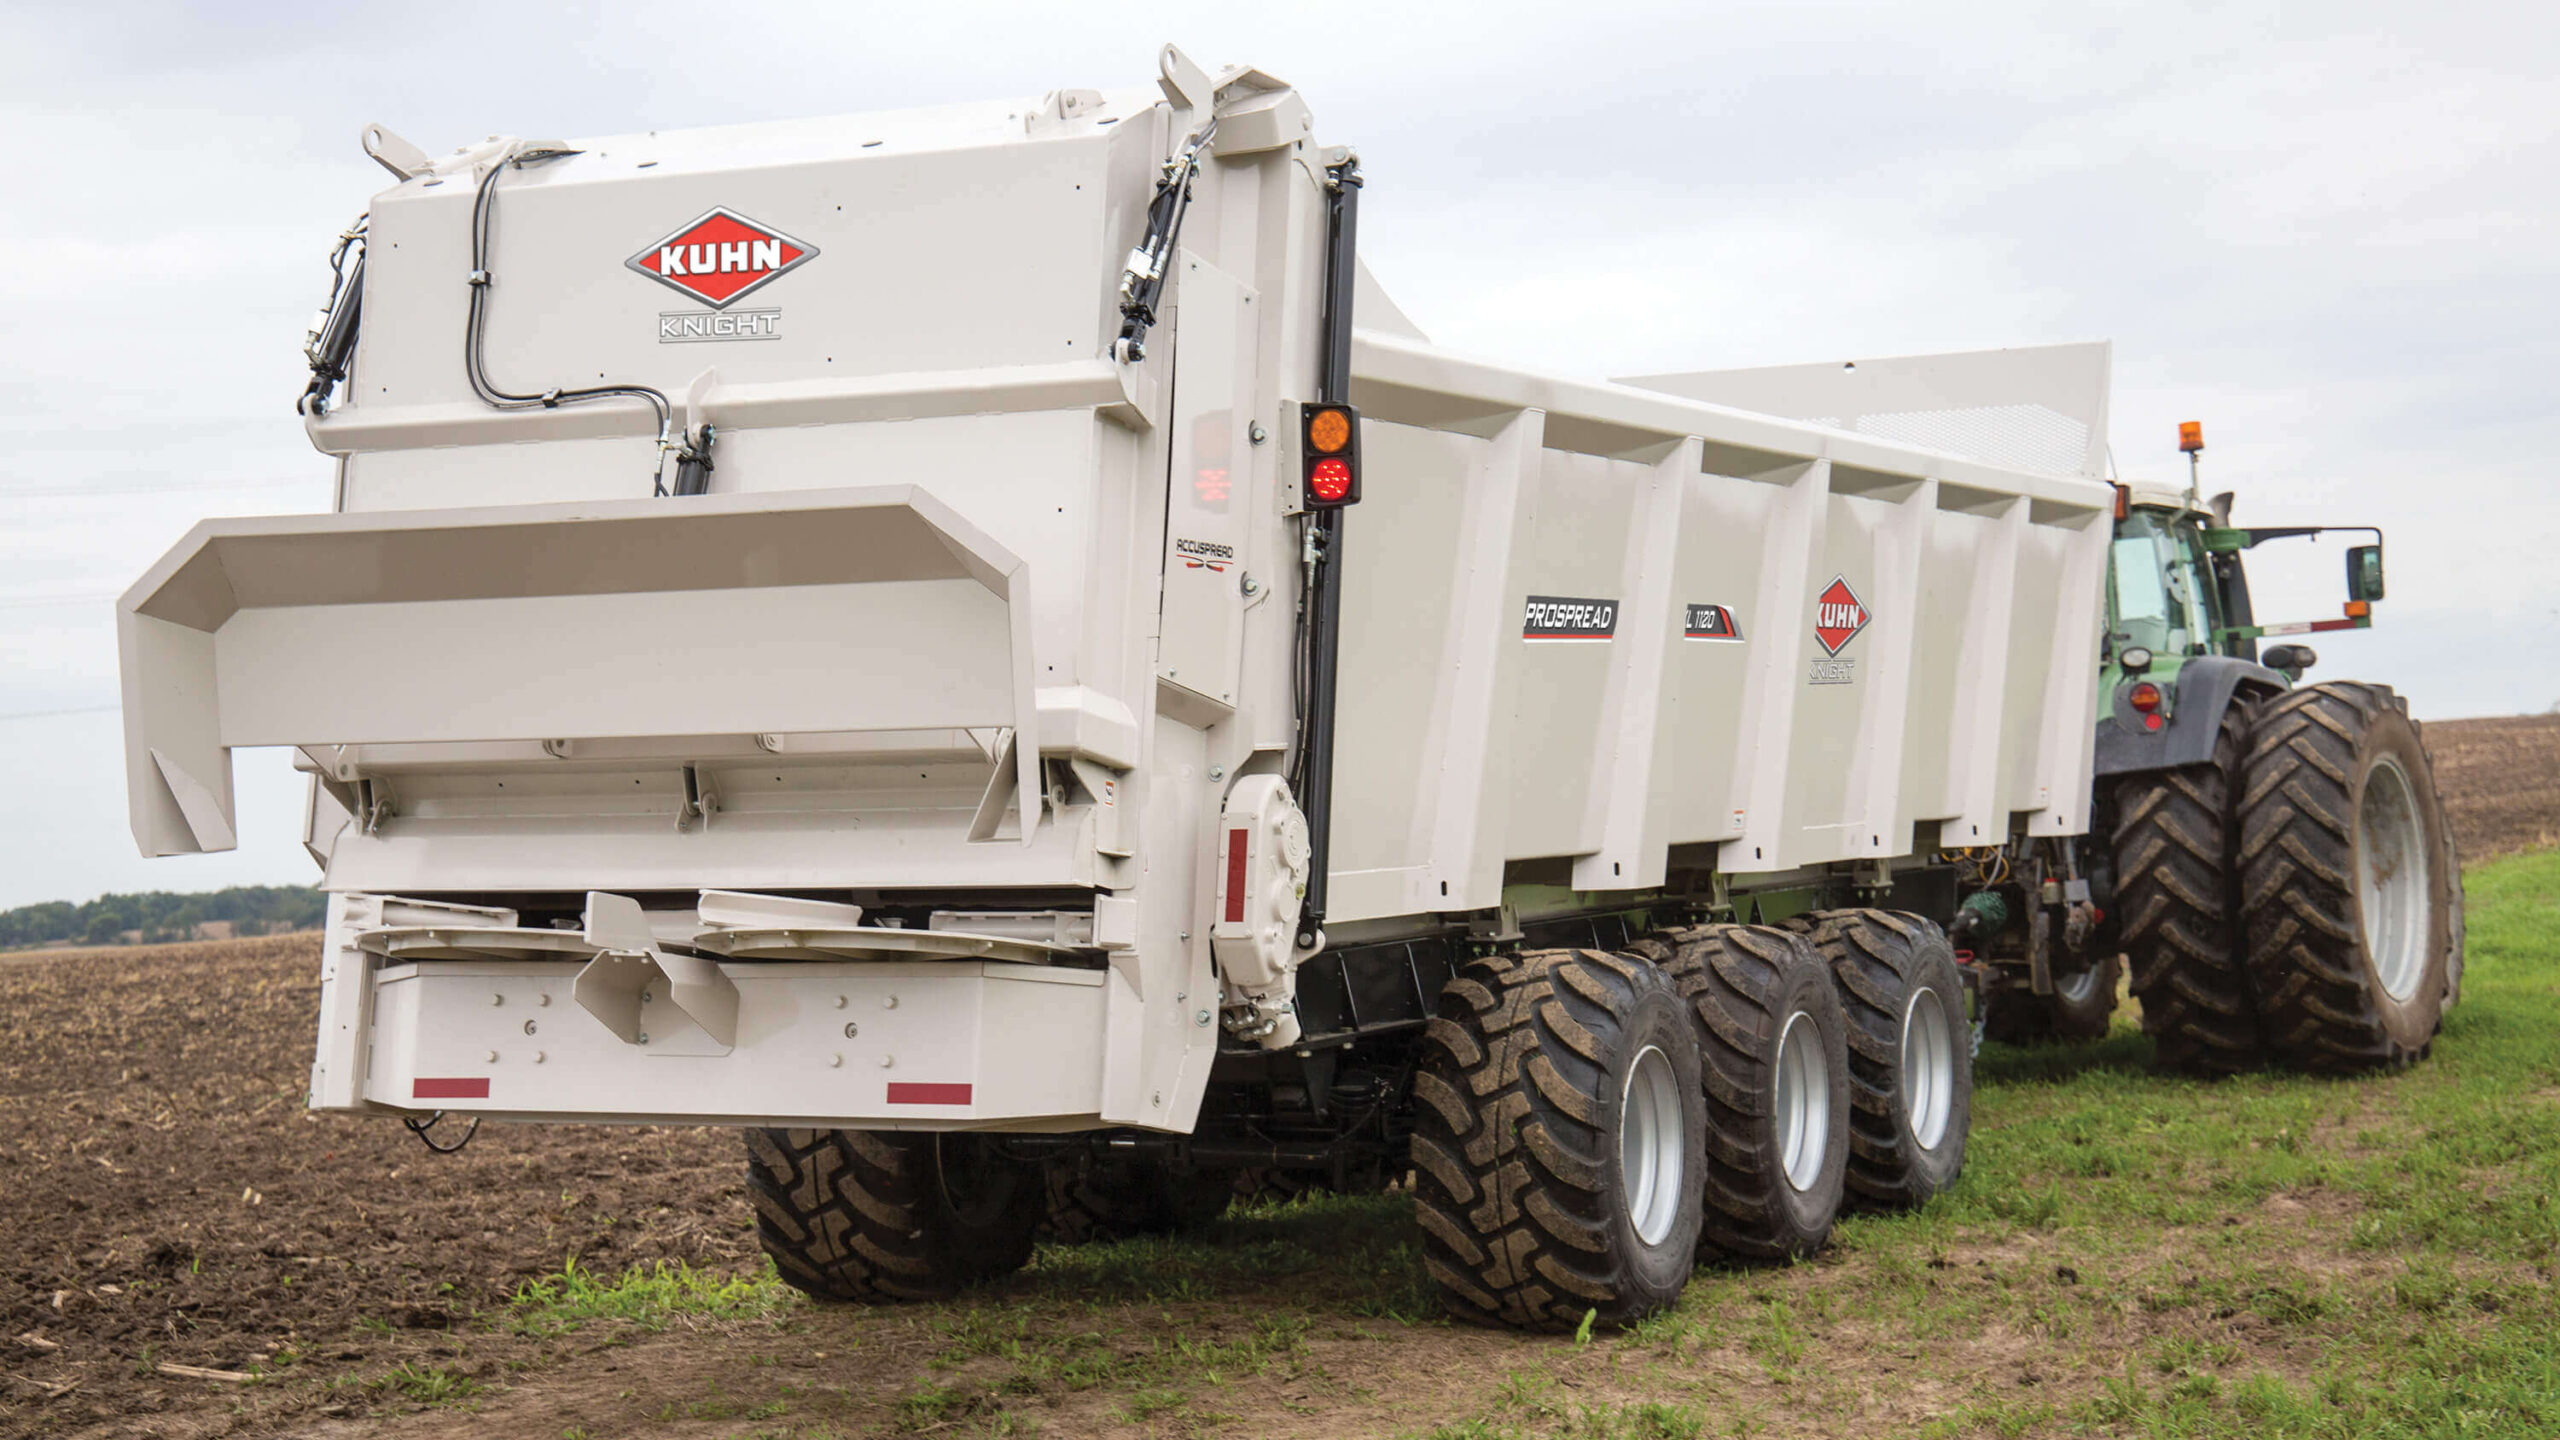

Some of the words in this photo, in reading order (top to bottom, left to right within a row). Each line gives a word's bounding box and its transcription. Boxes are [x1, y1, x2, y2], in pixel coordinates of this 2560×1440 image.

[659, 238, 782, 276] KUHN
[660, 313, 781, 337] KNIGHT
[1176, 538, 1234, 559] ACCUSPREAD
[1523, 602, 1612, 628] PROSPREAD
[1695, 610, 1715, 628] 1120
